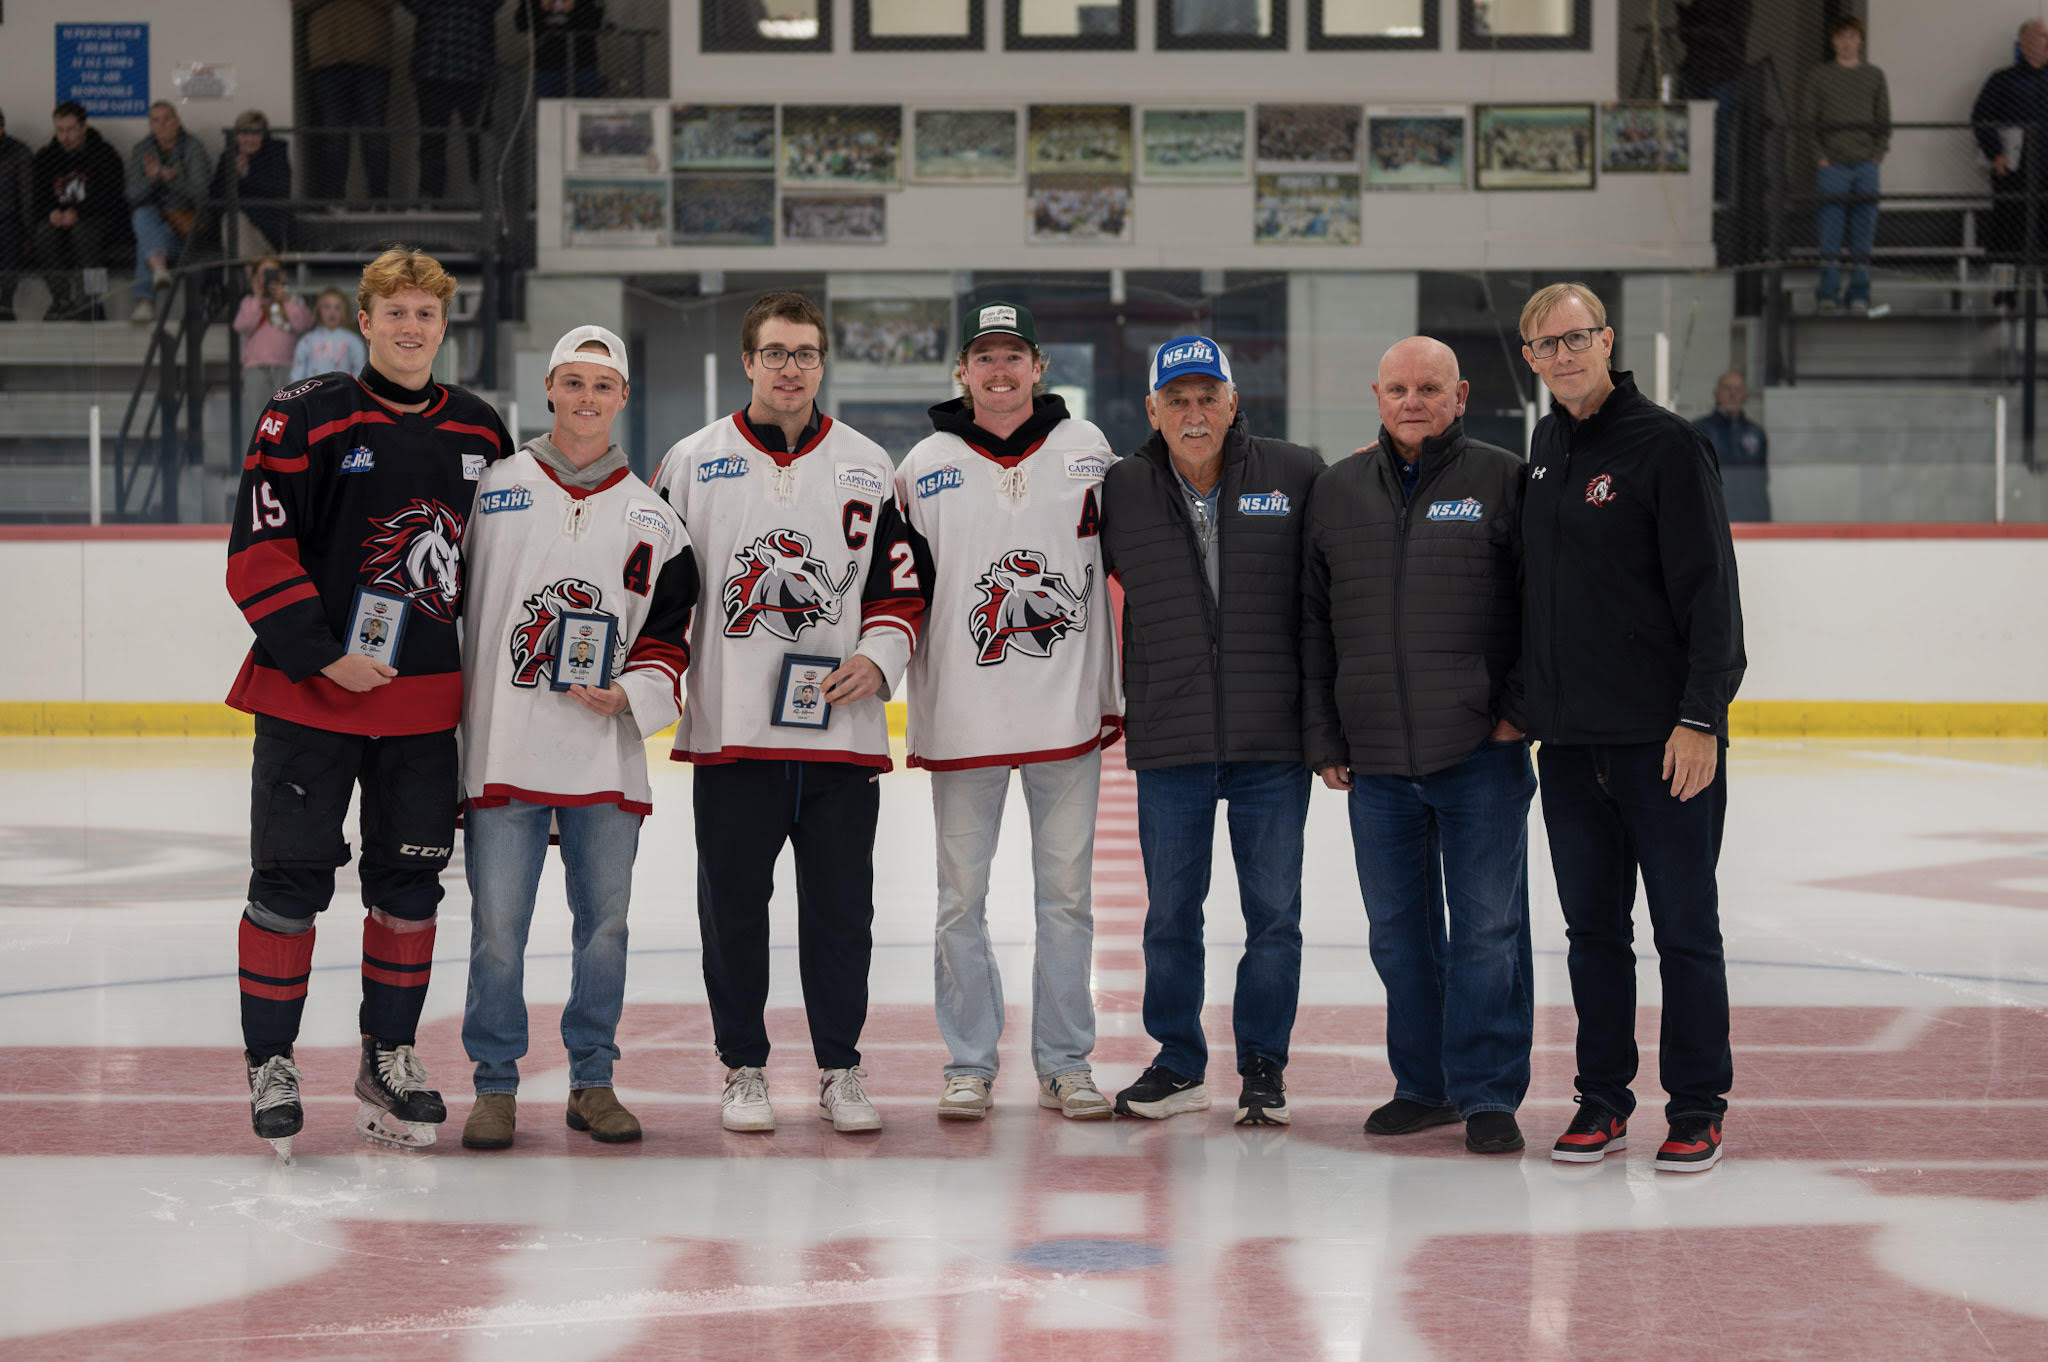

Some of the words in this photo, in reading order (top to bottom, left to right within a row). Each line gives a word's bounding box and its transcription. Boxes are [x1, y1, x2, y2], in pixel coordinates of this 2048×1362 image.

[1162, 347, 1214, 368] NSJHL
[261, 417, 284, 436] AF
[341, 451, 375, 469] SJHL
[698, 460, 749, 481] NSJHL
[1068, 464, 1108, 474] CAPSTON
[839, 473, 882, 489] CAPSTONE
[917, 471, 964, 498] NSJHL
[480, 491, 534, 512] NSJHL
[1238, 497, 1291, 512] NSJHL
[1426, 503, 1483, 518] NSJHL
[1077, 488, 1099, 539] A
[842, 499, 872, 551] C
[623, 541, 653, 597] A
[888, 541, 920, 590] 2
[400, 843, 450, 857] CCM
